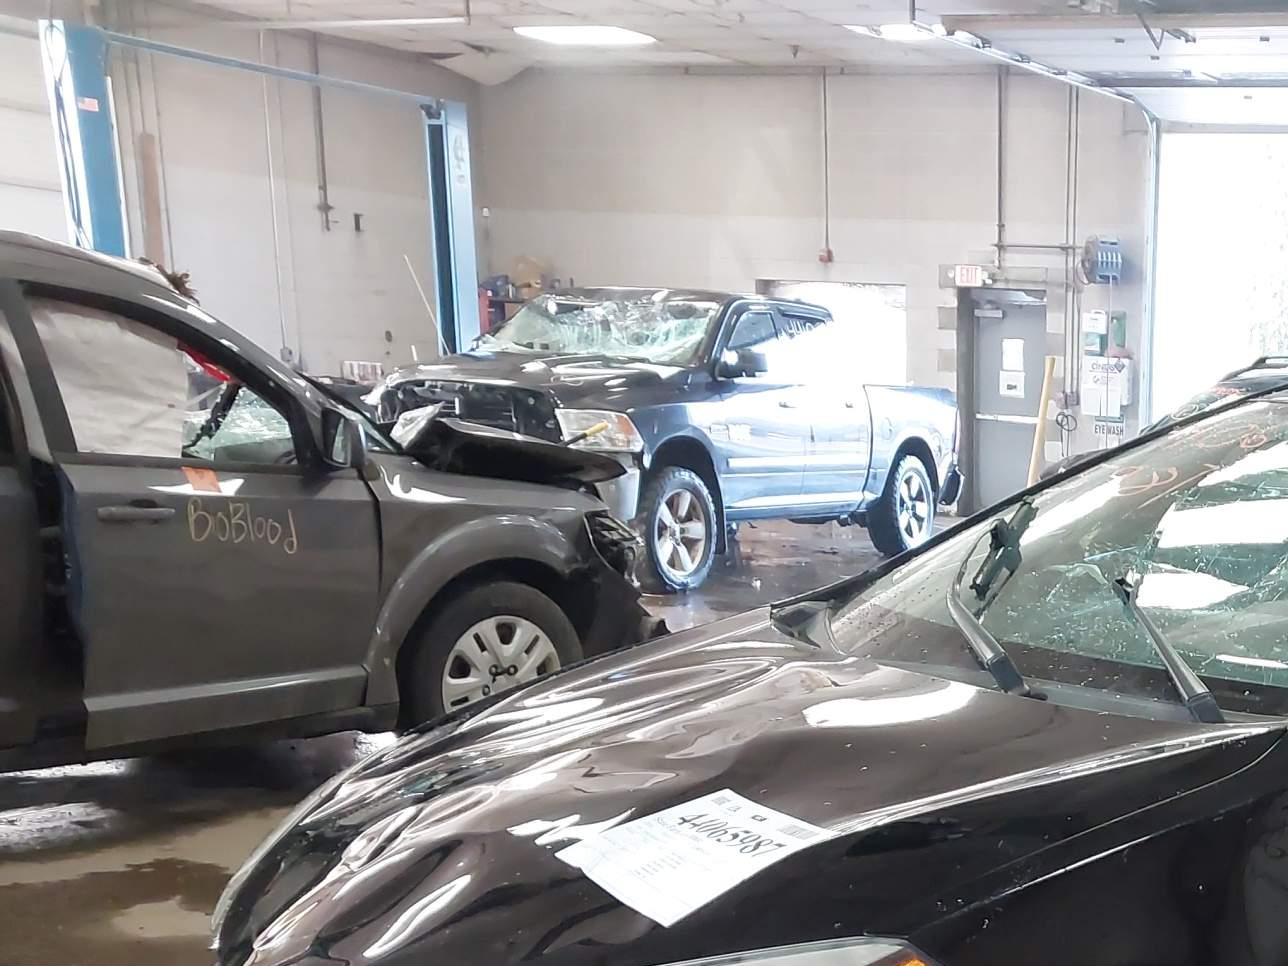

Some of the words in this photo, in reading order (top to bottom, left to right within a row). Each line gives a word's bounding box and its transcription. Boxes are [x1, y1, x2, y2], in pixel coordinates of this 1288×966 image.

[960, 266, 978, 284] EXIT
[1094, 424, 1106, 435] EYE
[1106, 425, 1124, 436] WASH
[677, 813, 787, 857] 44065987
